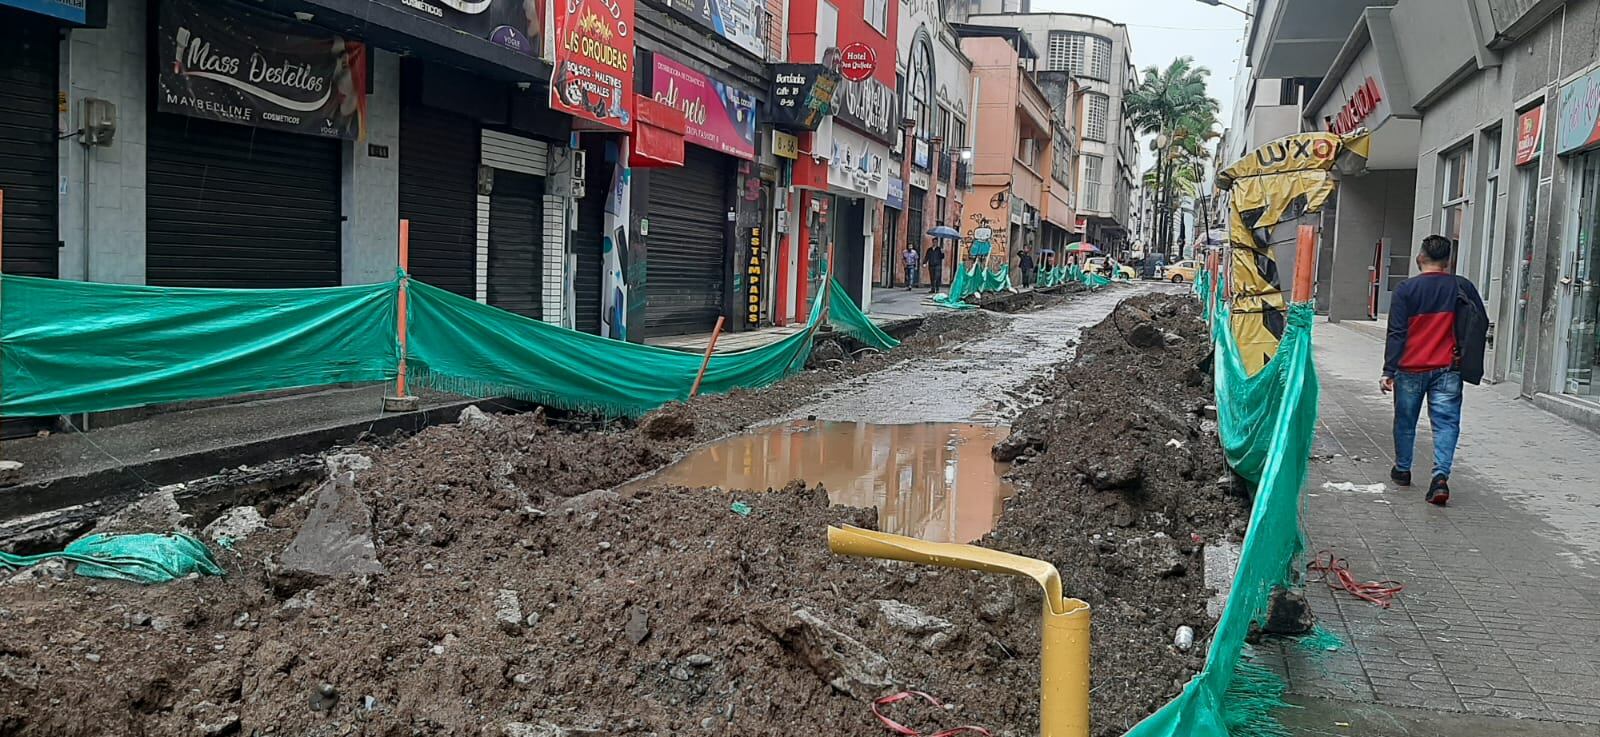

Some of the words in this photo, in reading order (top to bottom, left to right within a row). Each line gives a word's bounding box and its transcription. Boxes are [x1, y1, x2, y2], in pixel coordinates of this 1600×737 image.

[187, 36, 241, 74] Mass
[249, 51, 324, 93] Destellos
[581, 36, 628, 72] ORQUIDEAS
[847, 52, 866, 60] Hotel
[567, 61, 591, 78] BOLSOS
[595, 71, 622, 88] MALETINES
[776, 73, 806, 84] Bordados
[581, 80, 610, 97] MORRALES
[167, 93, 253, 117] MAYBELLINE
[262, 112, 300, 125] COSMETICOS
[748, 227, 761, 323] ESTAMPADOS
